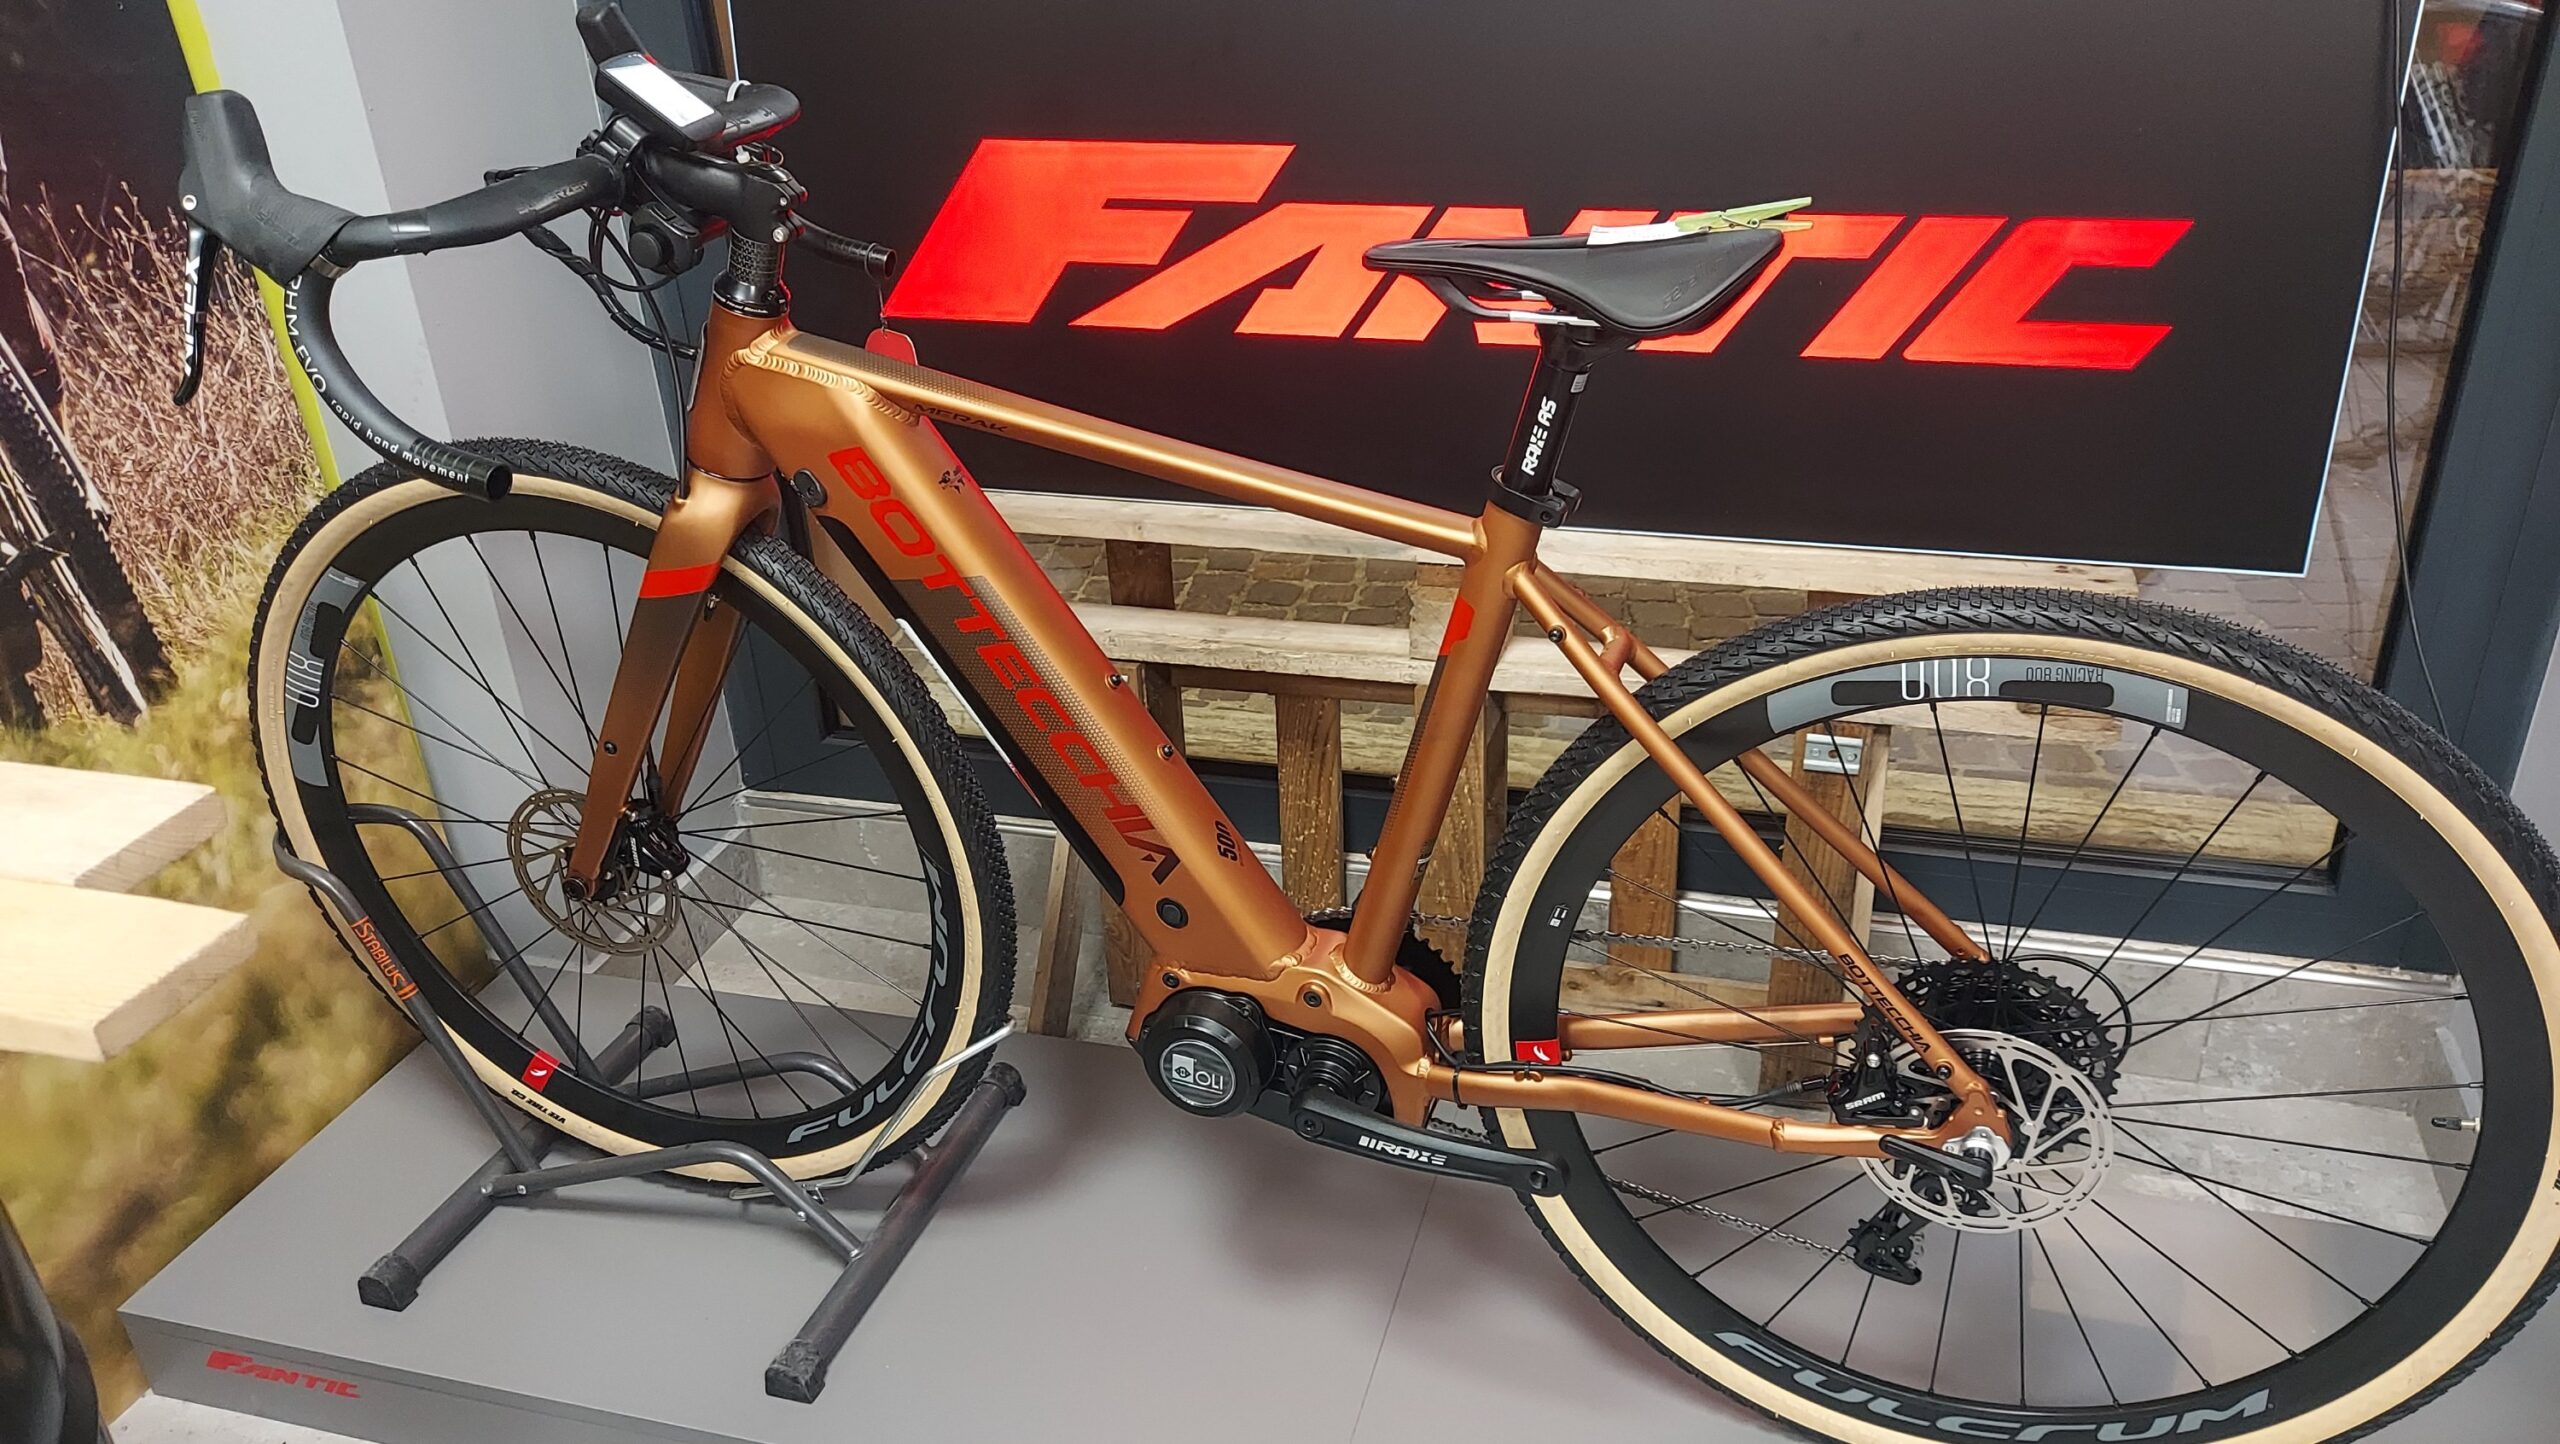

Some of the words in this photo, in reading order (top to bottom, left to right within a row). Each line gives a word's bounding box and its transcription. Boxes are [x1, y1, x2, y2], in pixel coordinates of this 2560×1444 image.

[914, 404, 1008, 432] MERAK
[1537, 396, 1557, 427] AS
[330, 399, 362, 431] rapid
[366, 428, 400, 454] hand
[402, 451, 470, 484] movement
[827, 446, 1180, 885] BOTTECCHIA
[2026, 666, 2052, 682] 800
[2056, 668, 2104, 683] RACING
[1215, 820, 1238, 862] 500
[354, 921, 409, 988] STABILUS
[787, 855, 948, 1144] FULCRUM
[1838, 953, 1932, 1054] BOTTECCHIA
[1195, 1070, 1224, 1091] OLI
[1844, 1091, 1886, 1111] SRAM
[206, 1350, 361, 1399] FANTIC
[1713, 1331, 2271, 1442] FULCRUM
